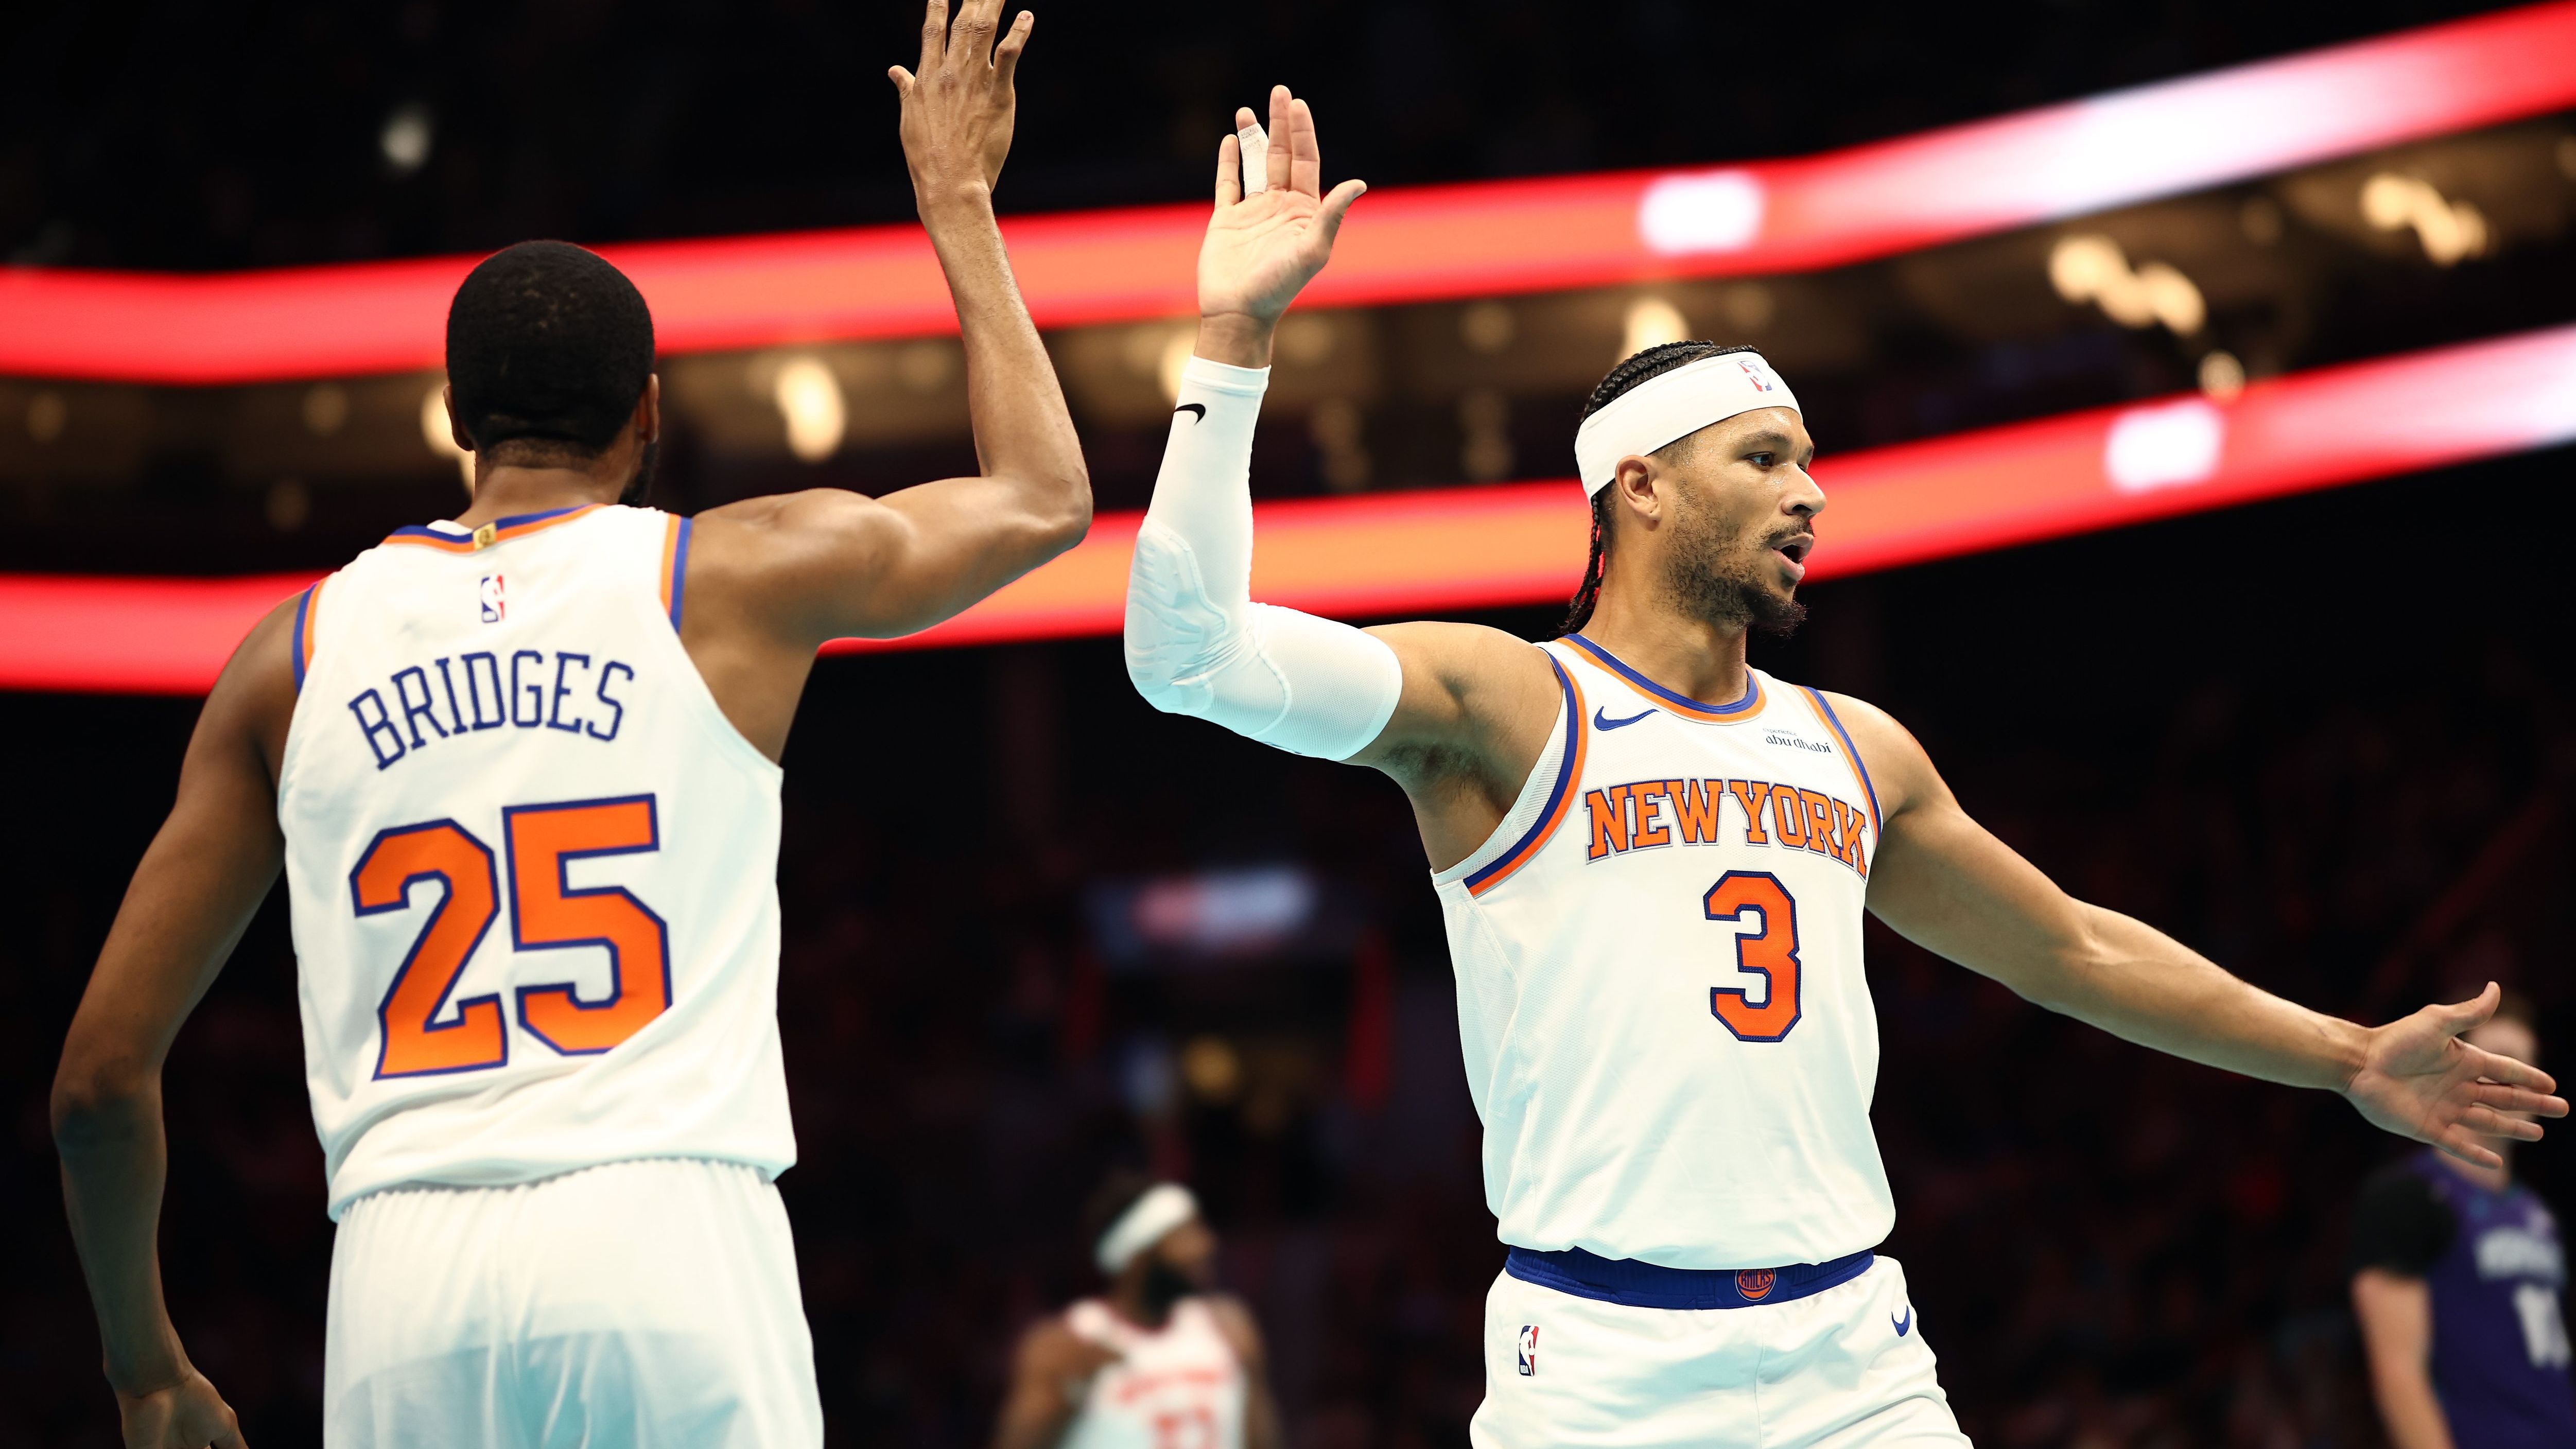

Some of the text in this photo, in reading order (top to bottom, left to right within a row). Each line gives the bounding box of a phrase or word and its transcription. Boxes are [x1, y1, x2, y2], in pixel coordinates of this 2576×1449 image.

[348, 650, 634, 771] BRIDGES
[1766, 735, 1831, 753] abu dhabi
[1583, 778, 1867, 883] NEW YORK
[349, 793, 673, 1081] 25
[1703, 870, 1802, 1042] 3
